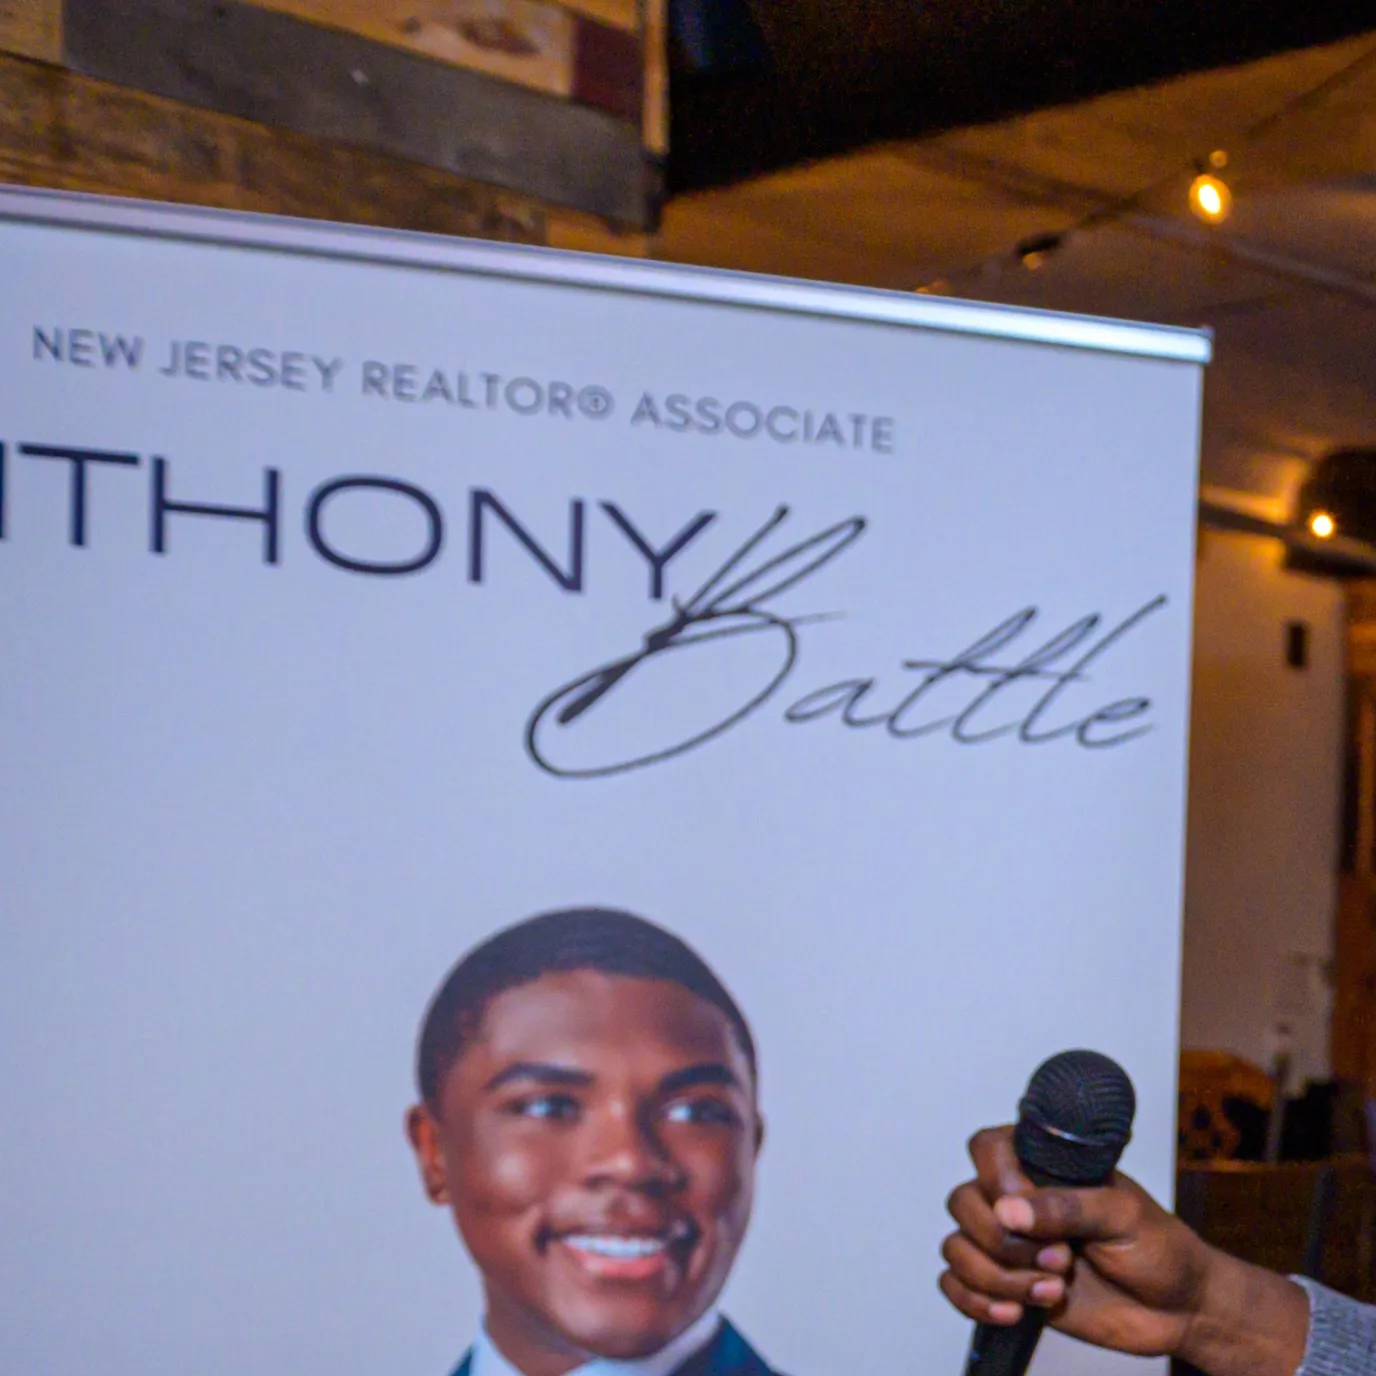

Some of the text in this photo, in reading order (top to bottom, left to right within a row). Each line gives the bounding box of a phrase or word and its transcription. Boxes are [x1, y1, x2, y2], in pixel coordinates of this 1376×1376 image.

[32, 325, 144, 370] NEW
[158, 339, 345, 393] JERSEY
[630, 391, 896, 453] ASSOCIATE
[0, 440, 717, 600] THONY
[525, 504, 1162, 778] Battle
